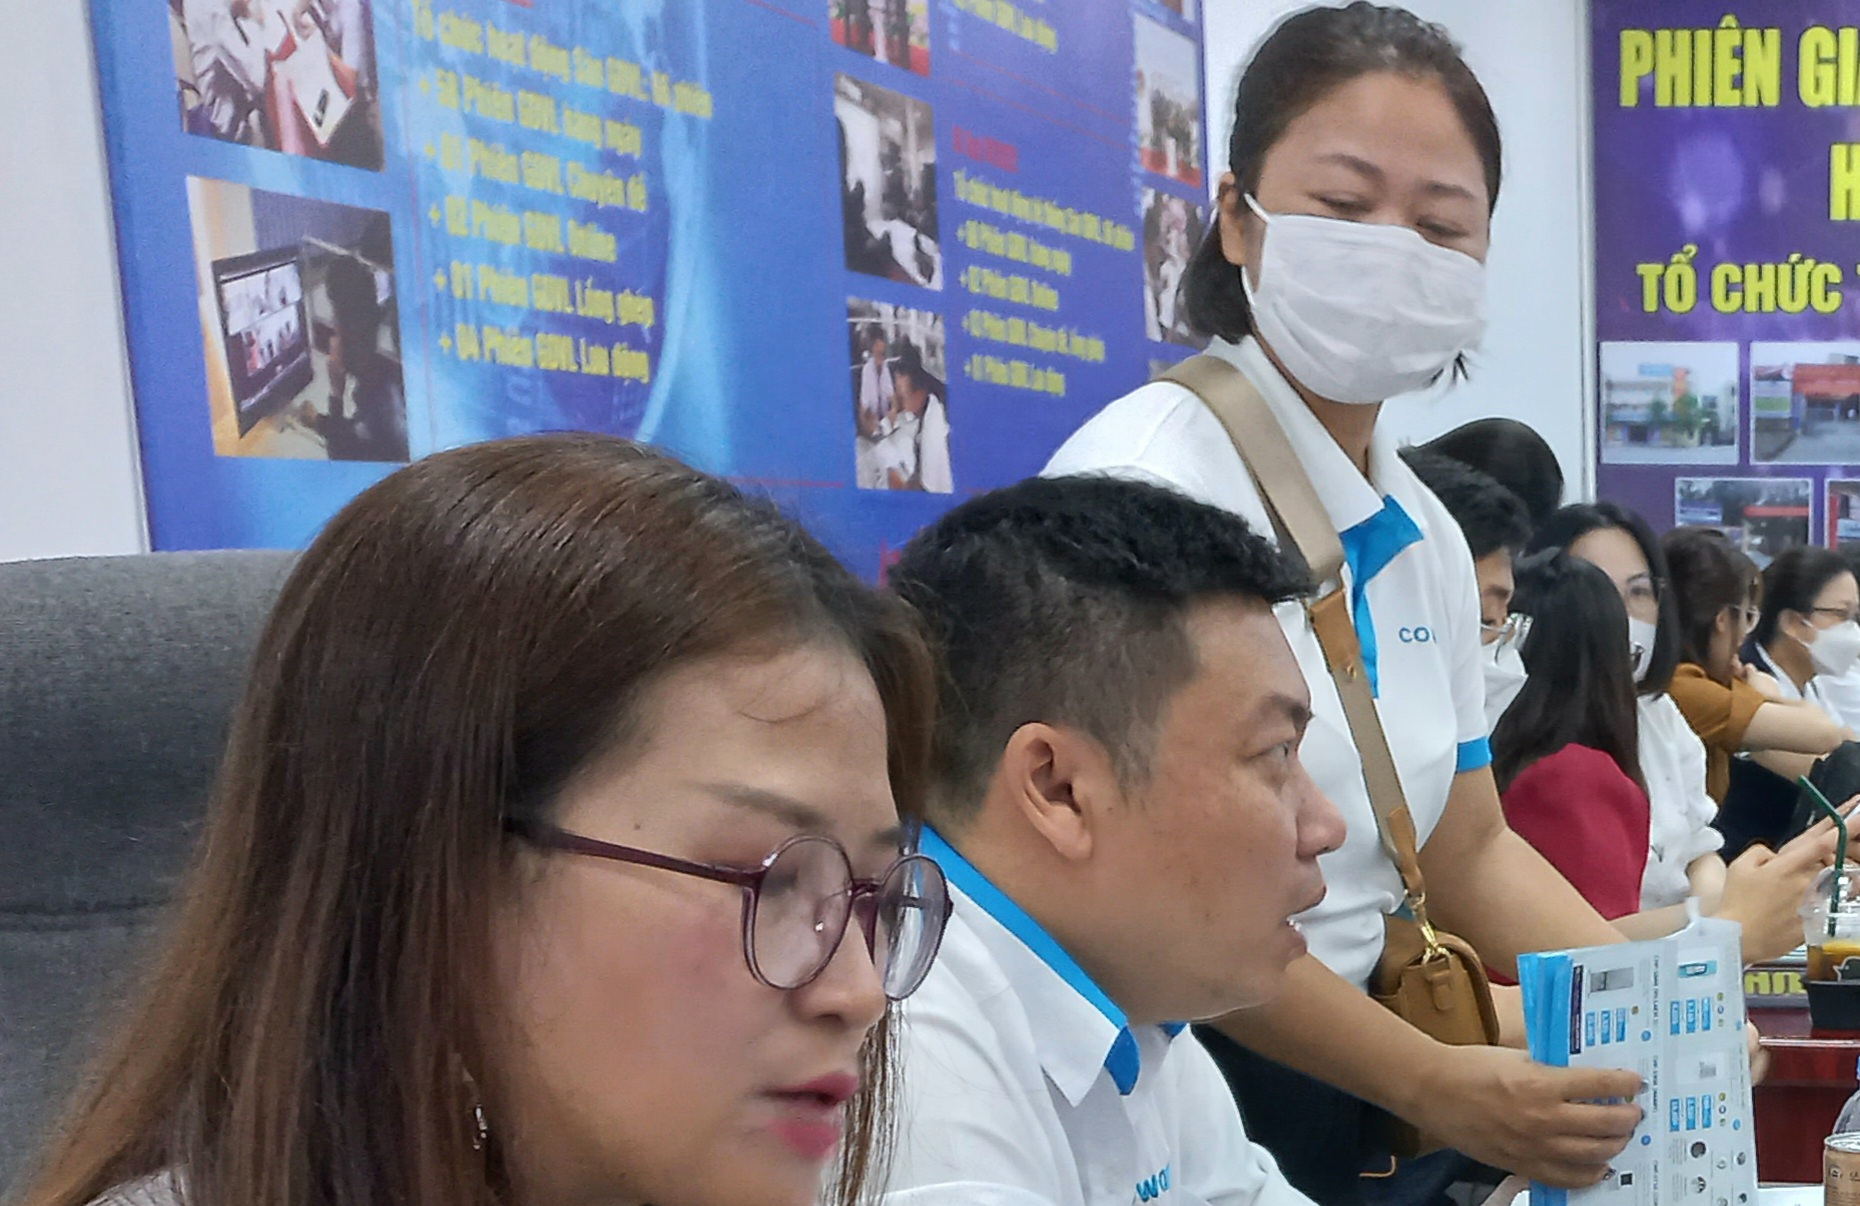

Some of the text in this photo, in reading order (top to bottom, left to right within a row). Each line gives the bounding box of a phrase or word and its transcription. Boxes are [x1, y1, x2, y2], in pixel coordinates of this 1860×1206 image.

[1619, 15, 1780, 107] PHIÊN
[1637, 244, 1698, 313] TỔ
[1711, 253, 1842, 313] CHỨC
